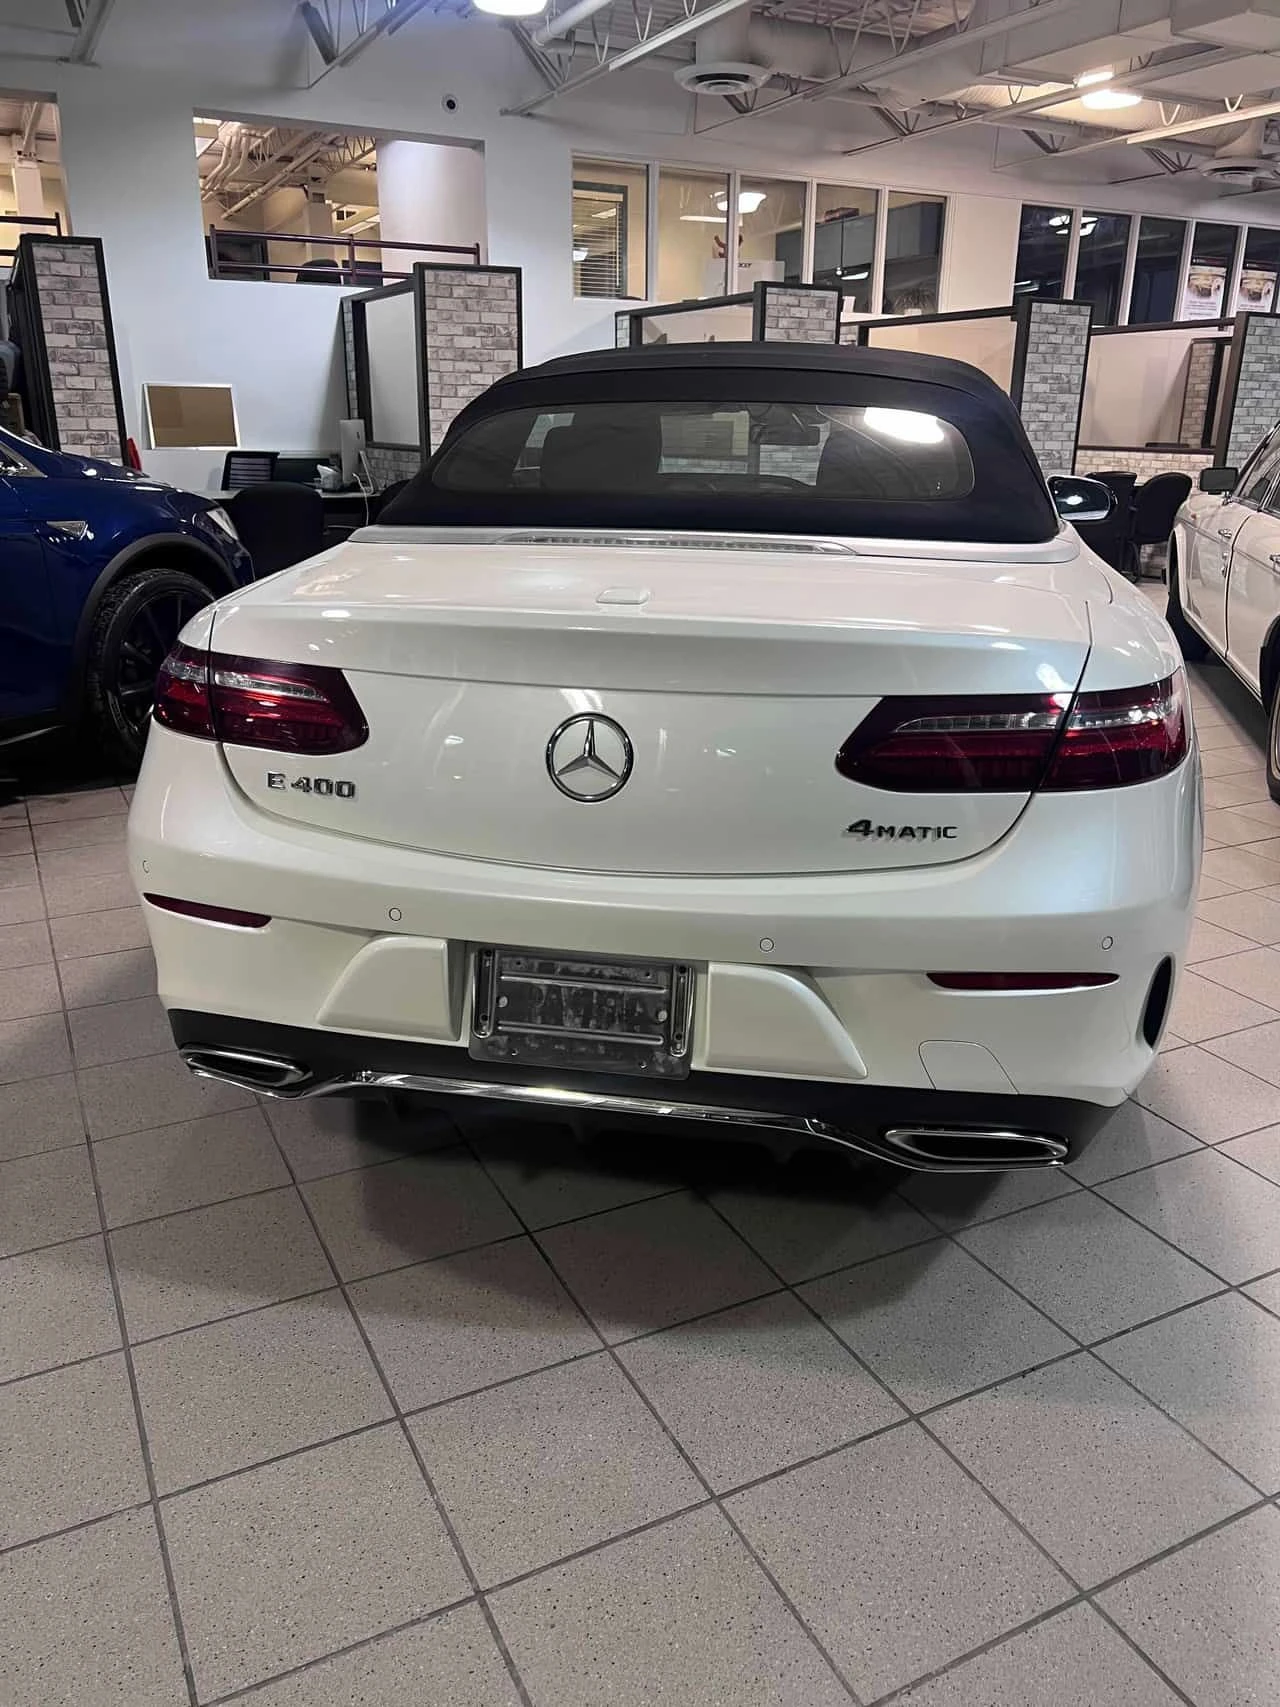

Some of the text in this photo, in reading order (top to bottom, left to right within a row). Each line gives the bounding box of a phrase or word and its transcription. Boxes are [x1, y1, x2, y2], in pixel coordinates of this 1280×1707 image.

[267, 771, 356, 798] E 400
[847, 819, 958, 839] 4MATIC
